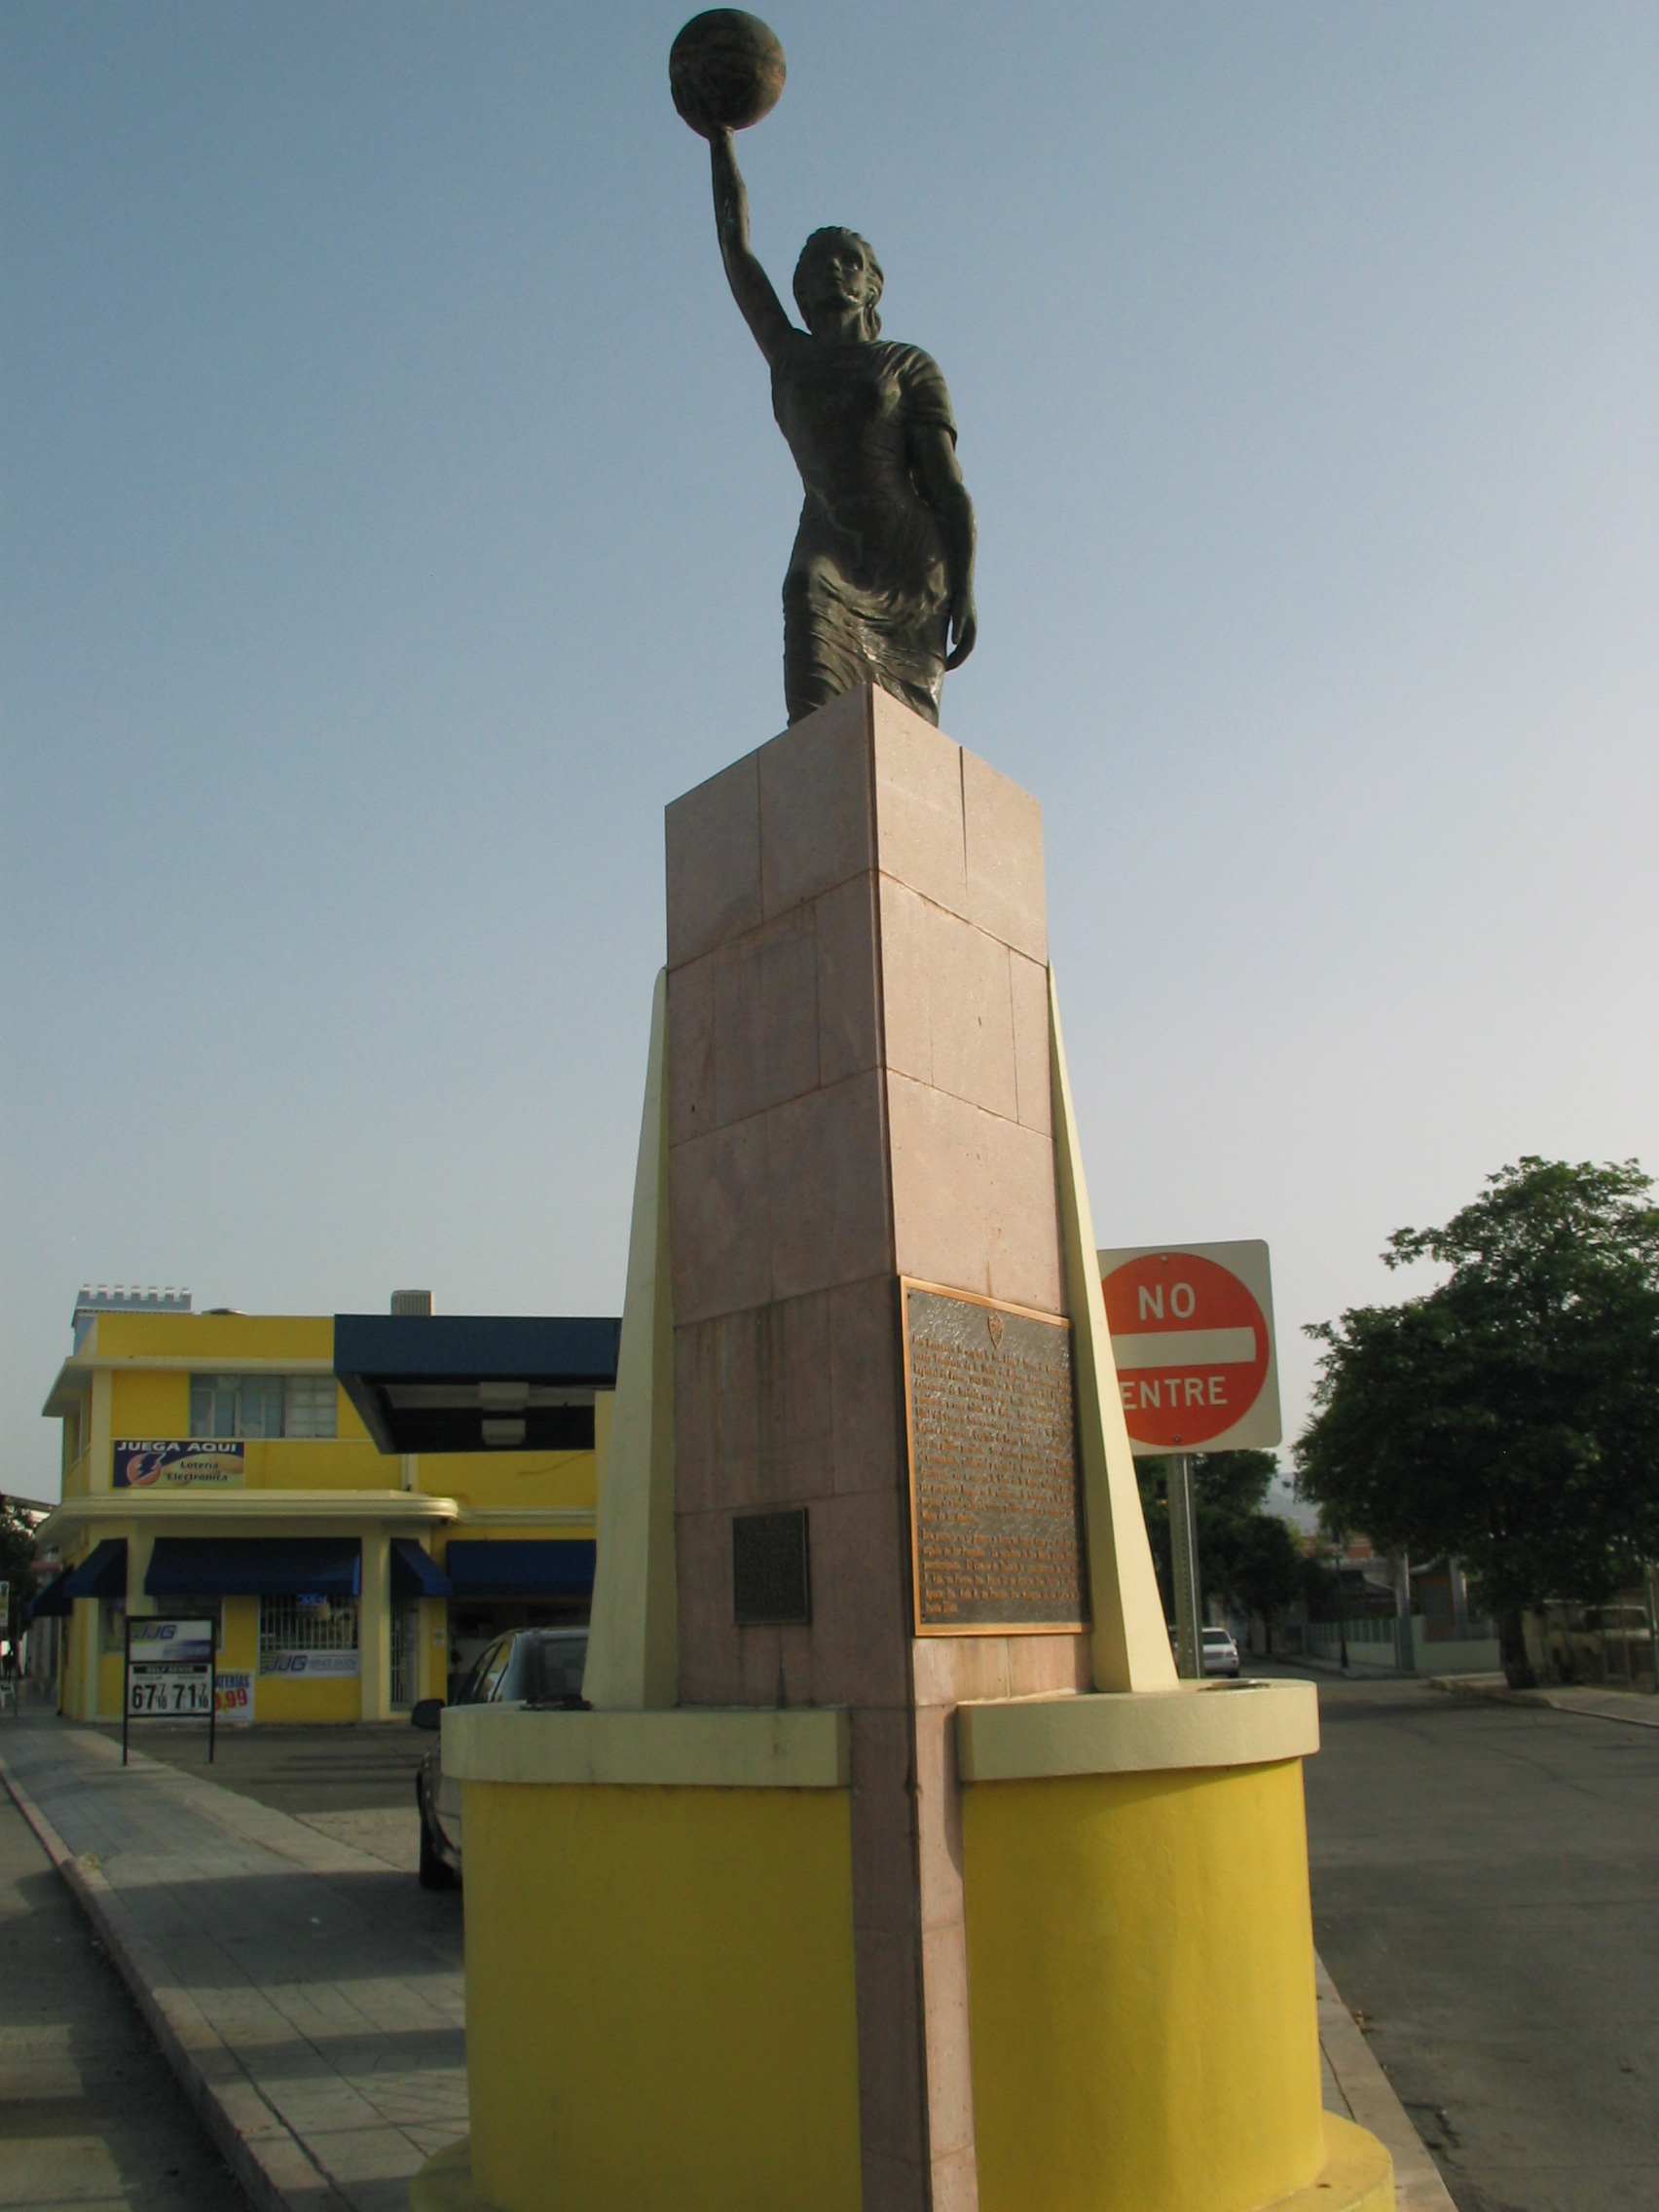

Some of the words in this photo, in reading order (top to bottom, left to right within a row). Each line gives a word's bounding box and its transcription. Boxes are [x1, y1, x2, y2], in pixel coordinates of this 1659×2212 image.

[1138, 1282, 1197, 1321] NO
[1119, 1376, 1228, 1411] ENTRE
[117, 1441, 180, 1452] JUEGA
[187, 1442, 237, 1453] AQUI
[134, 1624, 178, 1640] JJG
[266, 1655, 308, 1672] JJG
[215, 1674, 250, 1688] ATERÍAS
[132, 1683, 157, 1710] 67
[173, 1683, 196, 1710] 71
